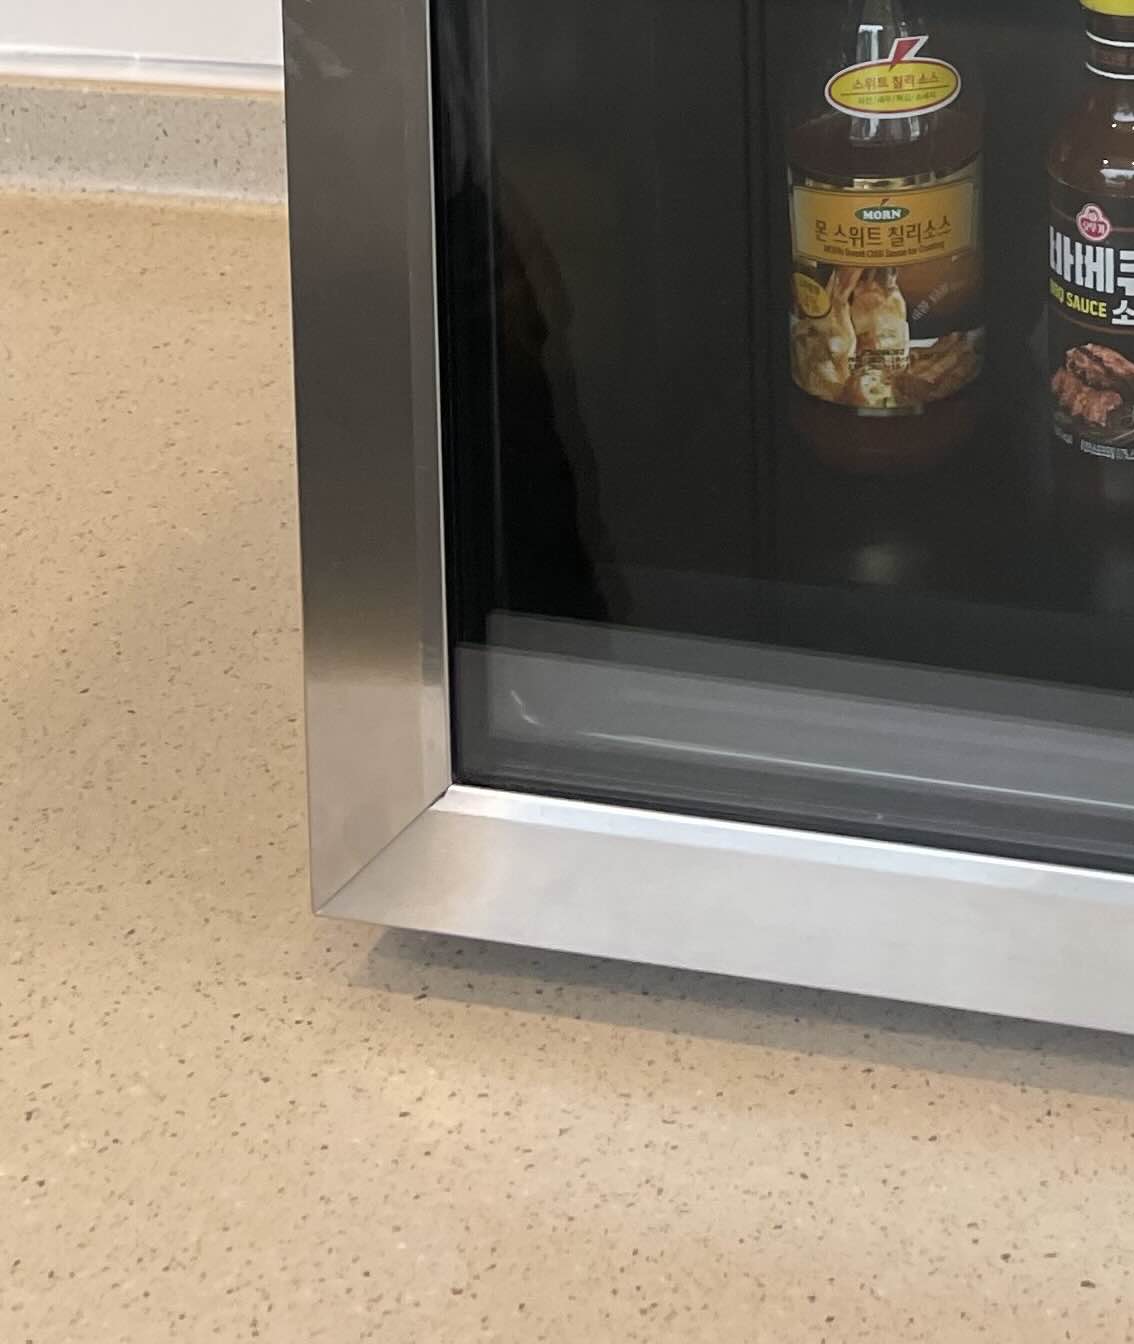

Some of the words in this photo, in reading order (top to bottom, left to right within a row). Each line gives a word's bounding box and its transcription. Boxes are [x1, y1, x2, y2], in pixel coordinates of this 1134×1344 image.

[862, 209, 902, 220] MORN
[815, 219, 828, 243] 몬
[832, 223, 882, 248] 스위트
[1066, 292, 1107, 318] SAUCE
